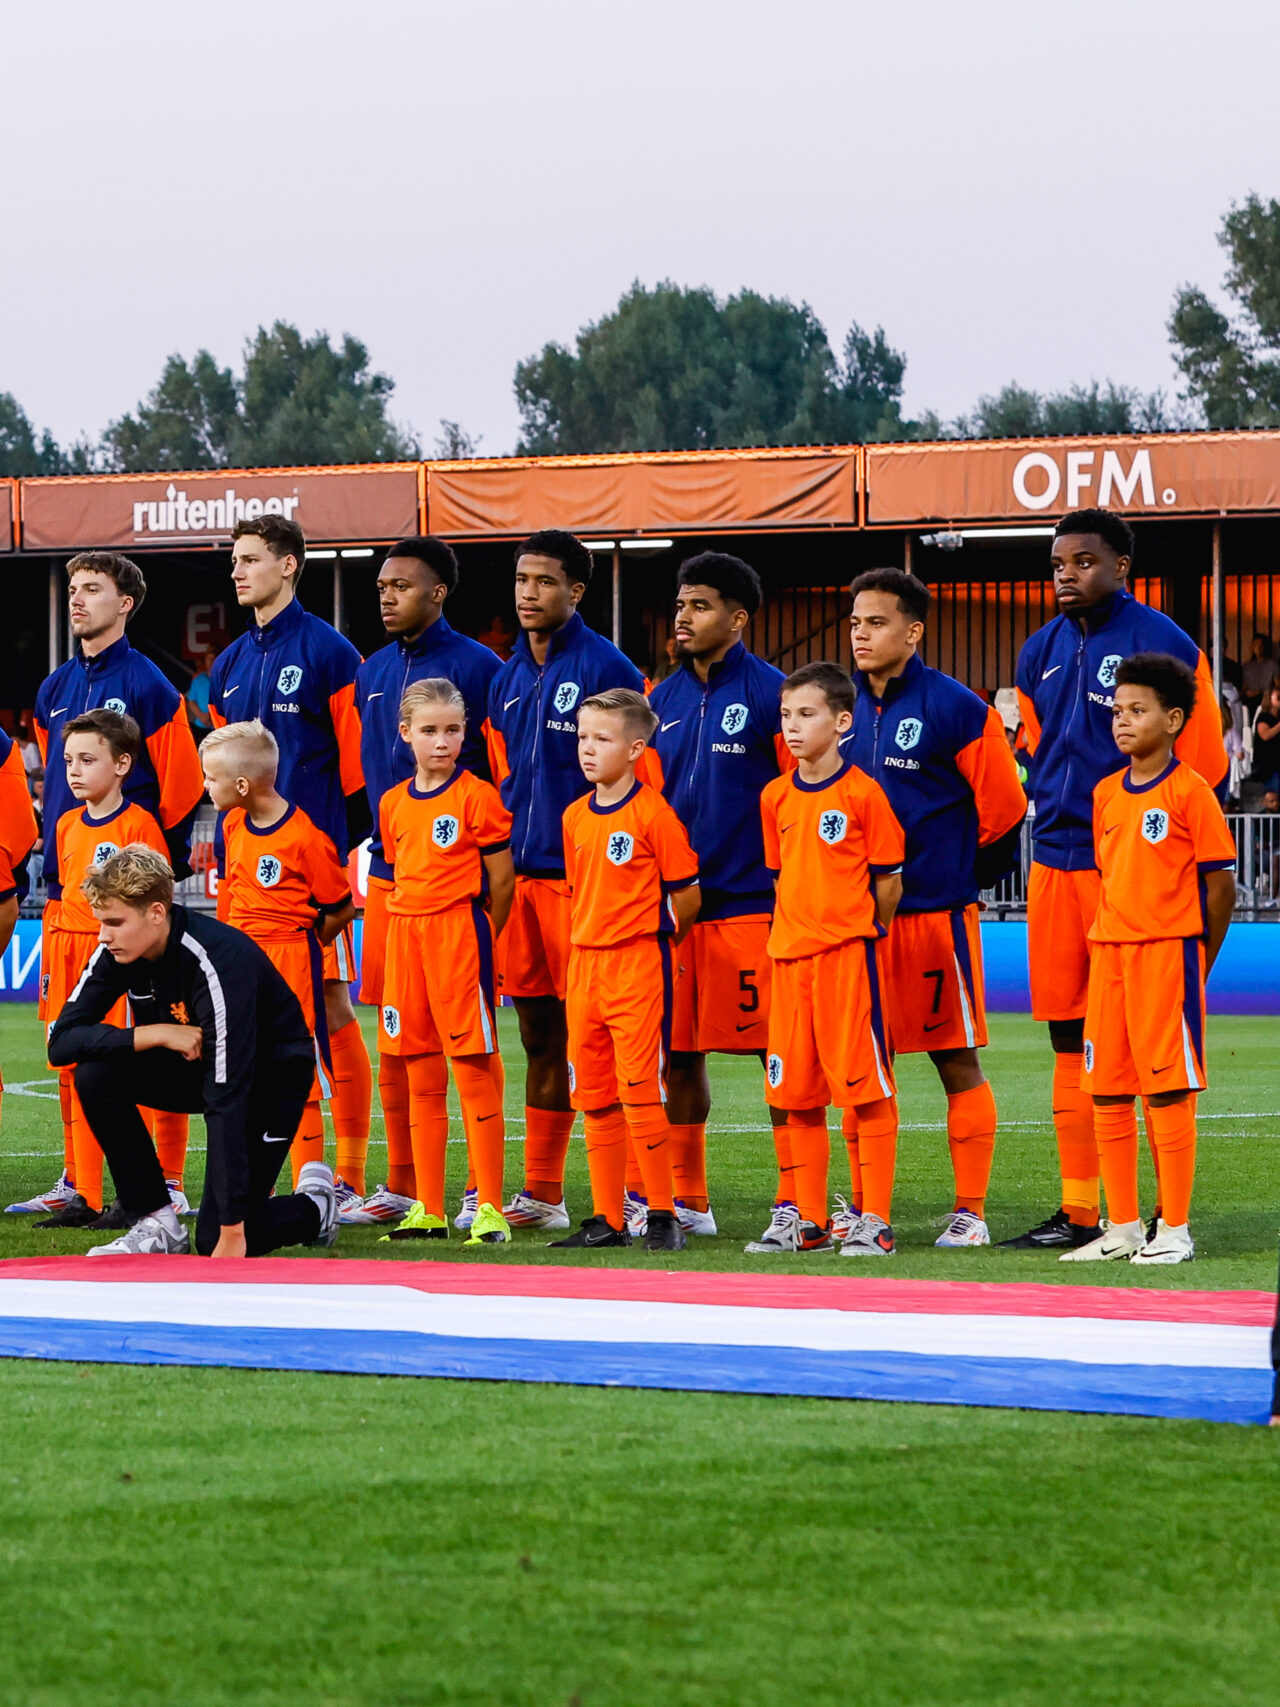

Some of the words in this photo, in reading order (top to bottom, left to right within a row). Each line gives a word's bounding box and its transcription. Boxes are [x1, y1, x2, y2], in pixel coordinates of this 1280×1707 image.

[133, 482, 299, 532] ruitenheer
[1087, 691, 1104, 704] NG
[712, 743, 731, 753] ING
[884, 756, 905, 768] ING
[738, 969, 759, 1012] 5
[923, 969, 944, 1013] 7
